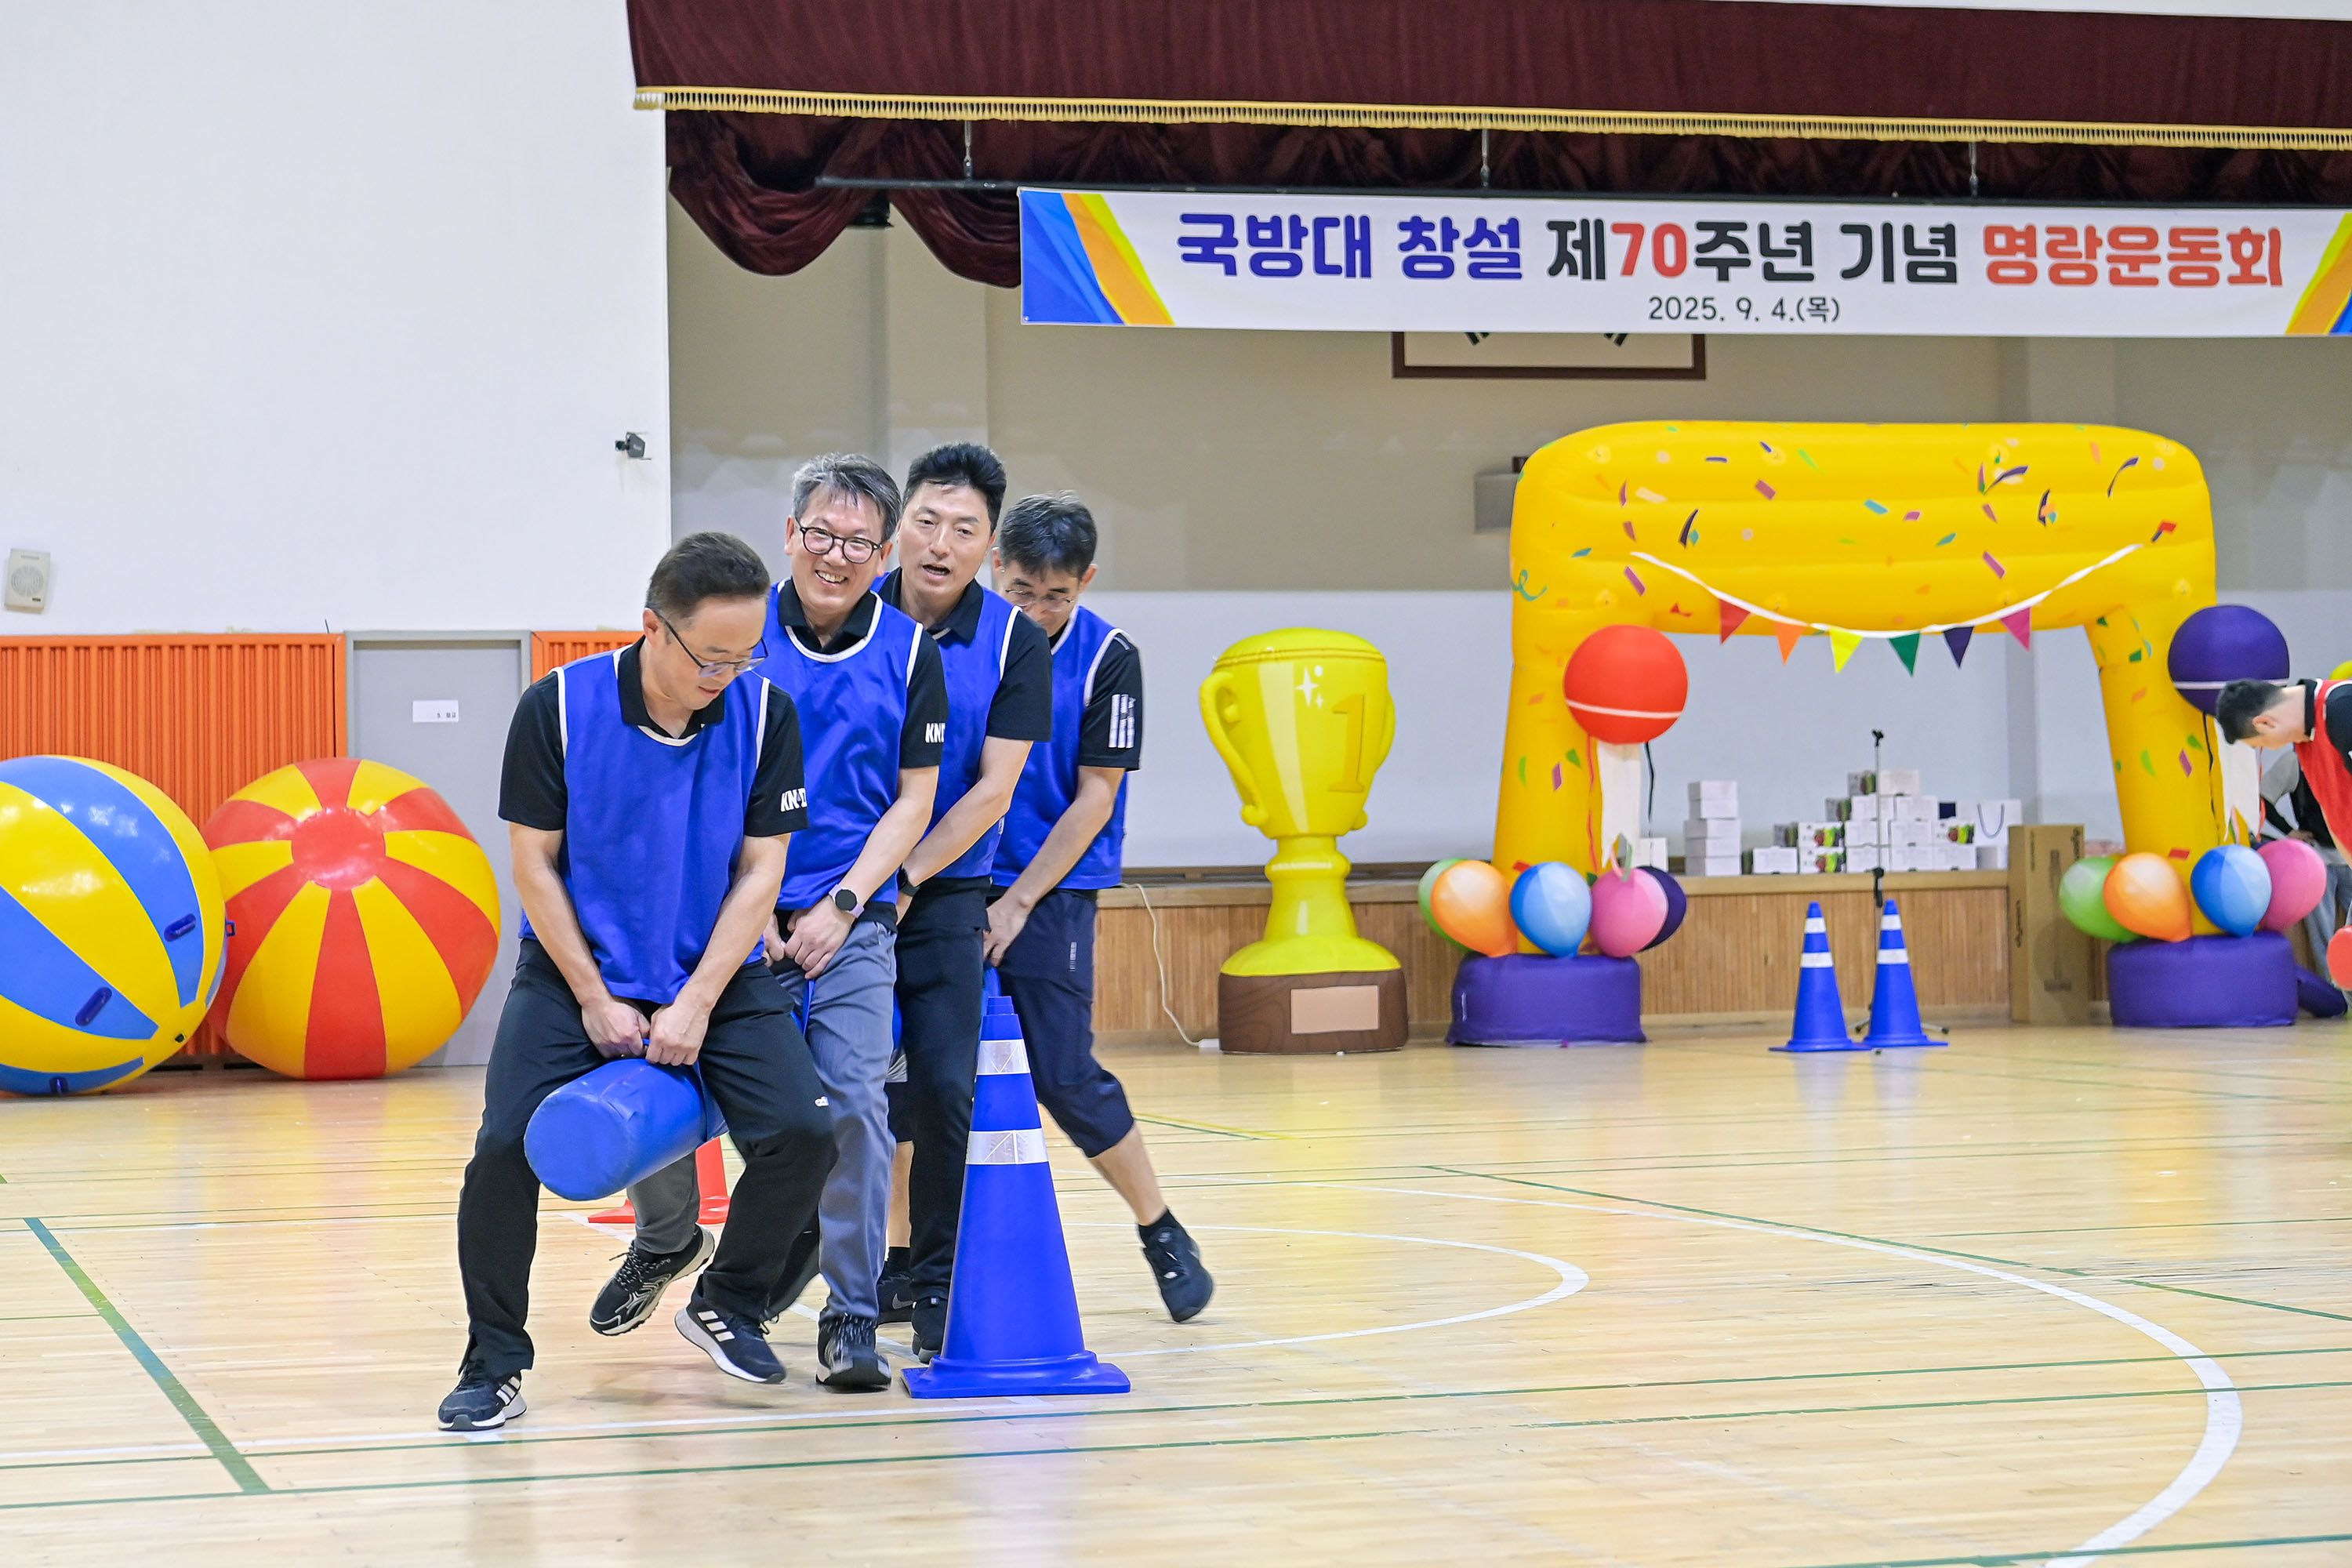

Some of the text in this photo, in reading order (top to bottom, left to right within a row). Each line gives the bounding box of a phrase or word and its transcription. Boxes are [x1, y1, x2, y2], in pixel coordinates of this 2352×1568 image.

[1177, 212, 2283, 287] 국방대 창설 제70주년 기념 명랑운동회
[1648, 296, 1840, 323] 2025. 9. 4.(목)
